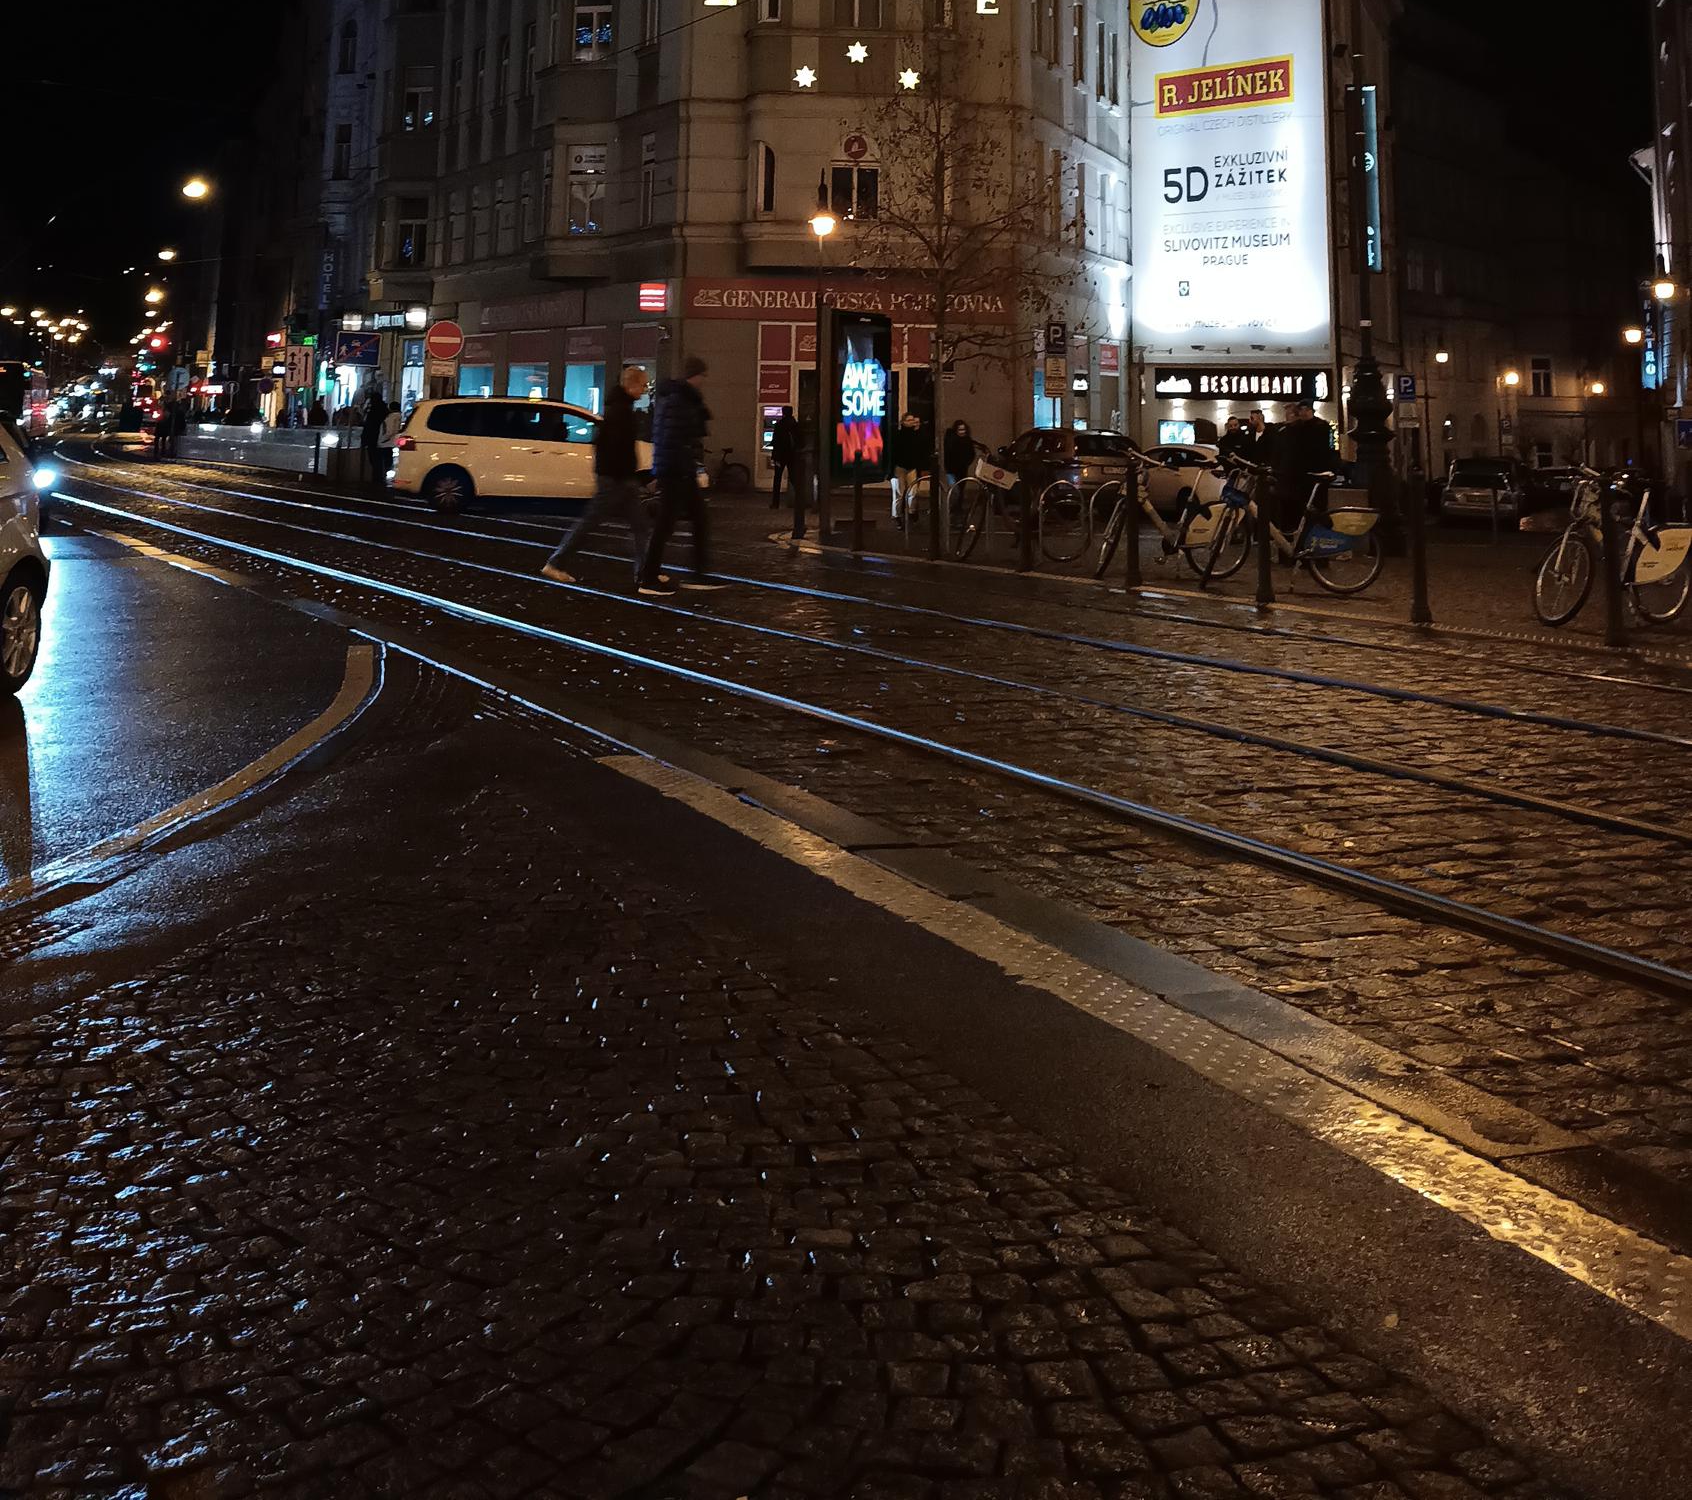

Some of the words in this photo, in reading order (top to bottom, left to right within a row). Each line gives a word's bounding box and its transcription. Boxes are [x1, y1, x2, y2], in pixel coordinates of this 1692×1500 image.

[1162, 84, 1184, 107] R.
[1188, 69, 1285, 104] JELÍNEK
[1214, 145, 1288, 168] EXKLUZIVNÍ
[1163, 166, 1209, 204] 5D
[1214, 167, 1288, 189] ZÁŽITEK
[1163, 236, 1229, 253] SLIVOVITZ
[1231, 232, 1291, 248] MUSEUM
[1202, 253, 1249, 266] PRAGUE
[322, 252, 334, 304] HOTEL
[722, 289, 818, 309] GENERALI
[889, 293, 1006, 313] POJIOVNA
[1200, 375, 1303, 395] RESTAURANT
[841, 389, 886, 417] SOME
